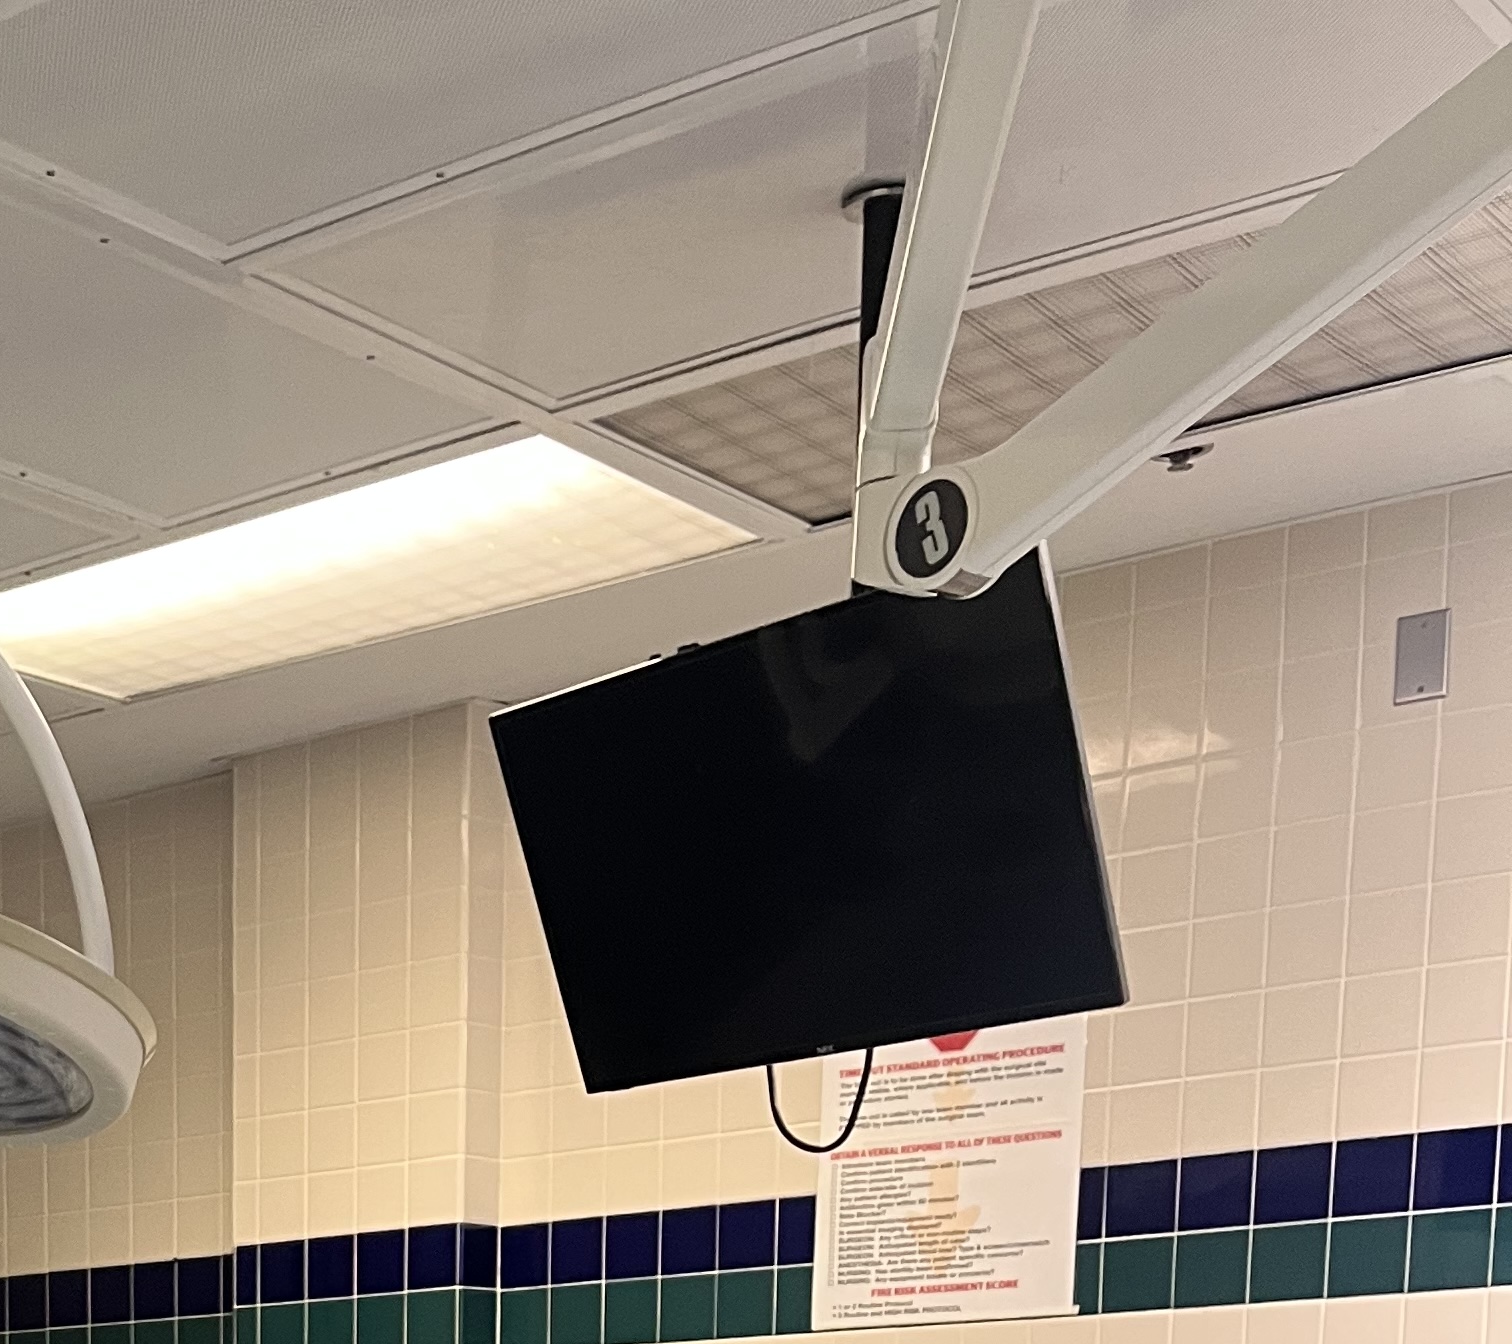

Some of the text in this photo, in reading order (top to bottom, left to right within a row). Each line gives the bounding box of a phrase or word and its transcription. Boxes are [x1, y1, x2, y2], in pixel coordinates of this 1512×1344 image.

[915, 490, 950, 565] 3
[840, 1043, 1065, 1078] TIME UT STANDARD OPERATING PROCEDURE
[868, 1147, 899, 1157] VERBAL
[901, 1142, 942, 1153] RESPONSE
[945, 1141, 956, 1149] TO
[957, 1139, 971, 1148] ALL
[973, 1137, 985, 1146] OF
[987, 1135, 1011, 1145] THESE
[1013, 1129, 1062, 1143] QUESTIONS
[871, 1279, 1019, 1297] FIRE RISK ASSESSMENT SCORE
